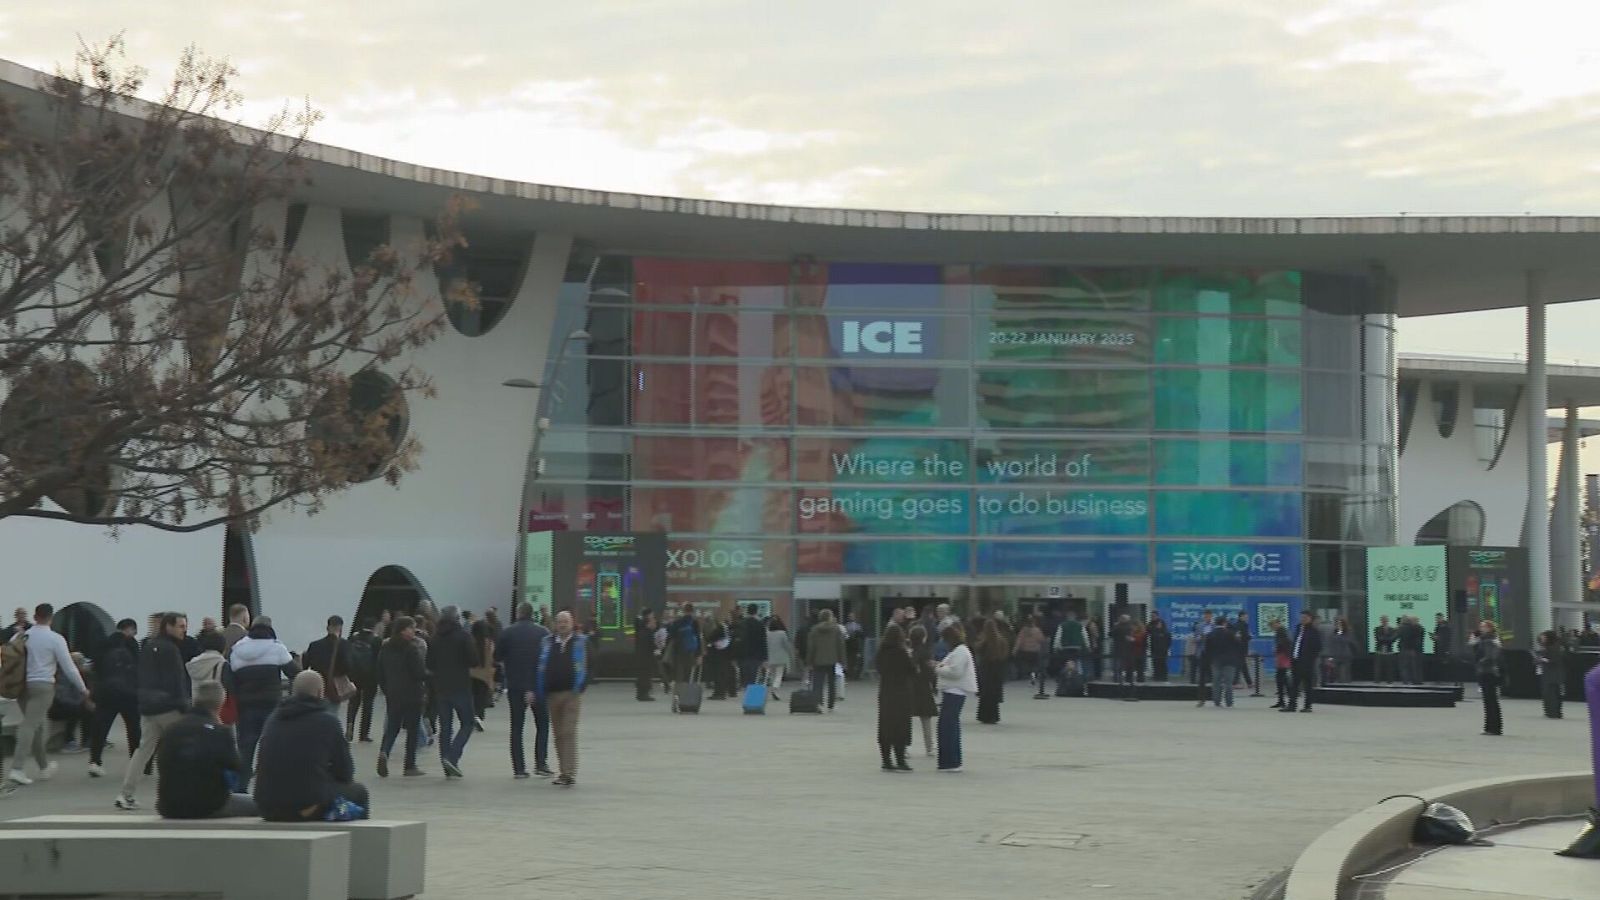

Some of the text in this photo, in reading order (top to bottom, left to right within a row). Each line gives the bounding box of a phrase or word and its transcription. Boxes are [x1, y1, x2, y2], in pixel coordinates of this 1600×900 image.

[842, 321, 923, 354] ICE
[989, 331, 1136, 346] 20-22 JANUARY 2025
[832, 453, 1092, 477] Where the world of
[799, 491, 1147, 520] gaming goes to do business
[665, 549, 763, 569] XPLORE
[1172, 552, 1281, 572] EXPLORE
